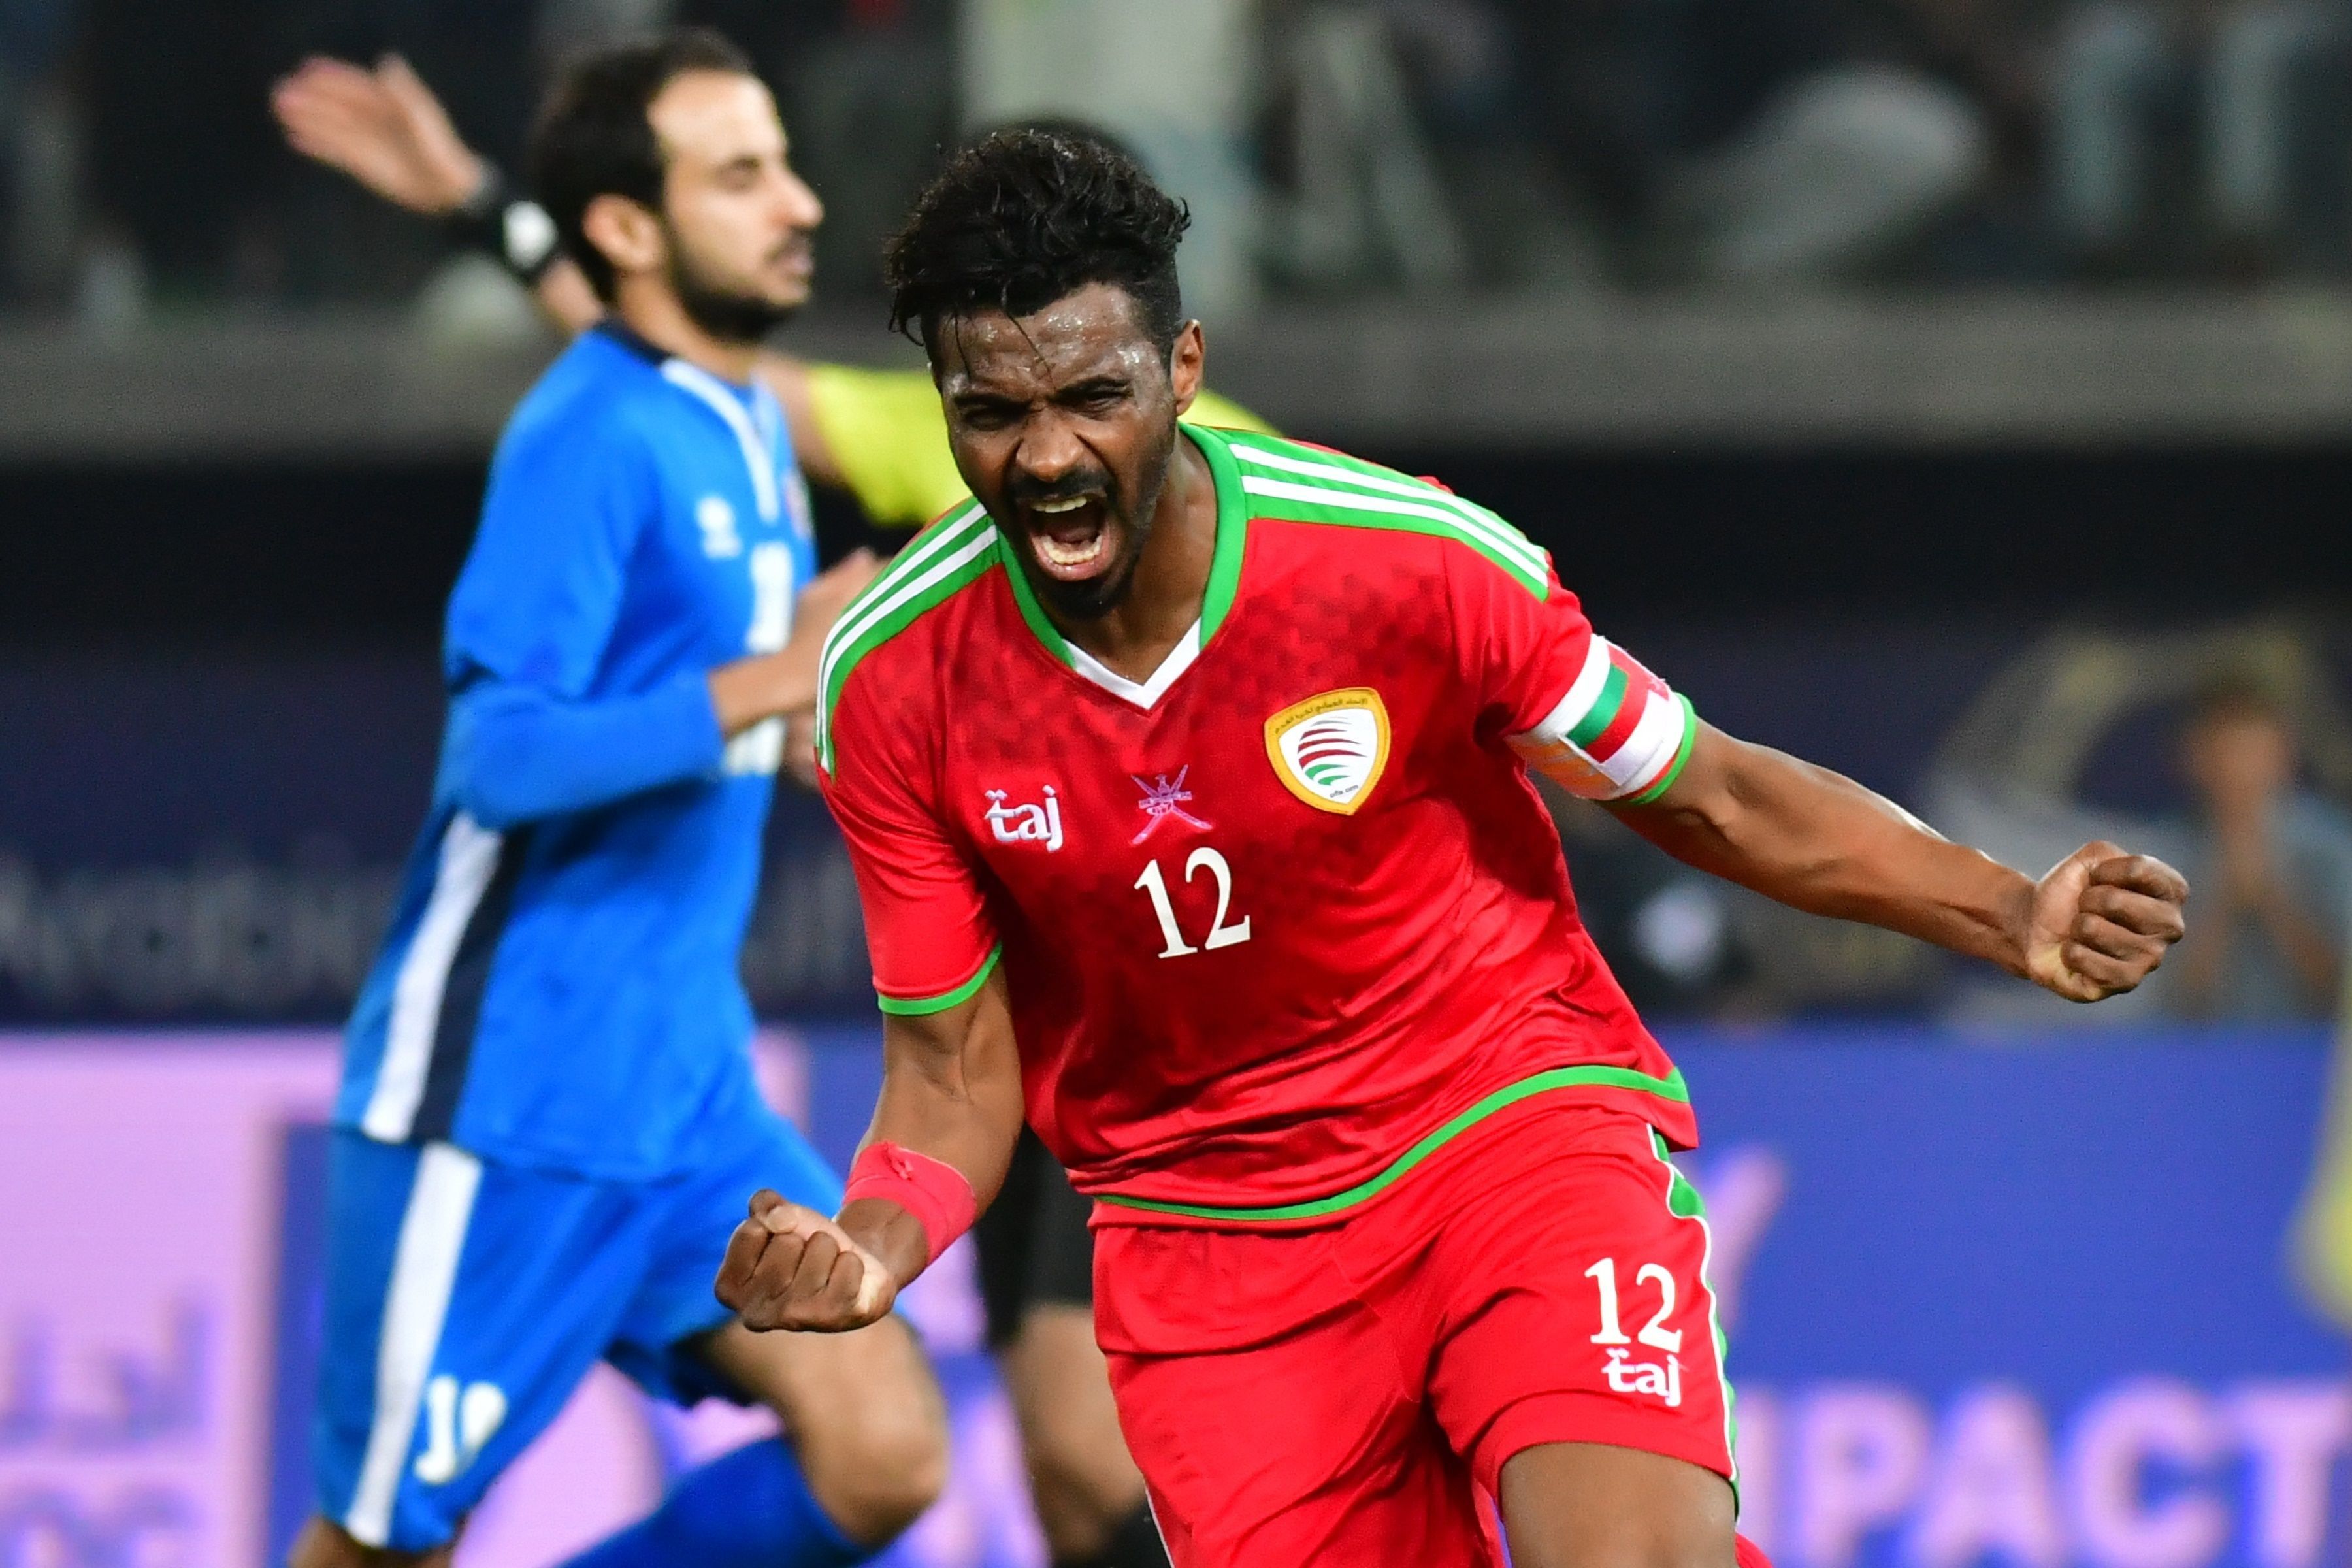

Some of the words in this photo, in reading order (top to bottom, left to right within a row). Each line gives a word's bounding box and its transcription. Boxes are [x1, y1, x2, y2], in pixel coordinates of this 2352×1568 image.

[983, 784, 1064, 853] taj
[1134, 847, 1251, 958] 12
[1584, 1257, 1683, 1354] 12
[1601, 1347, 1682, 1407] taj
